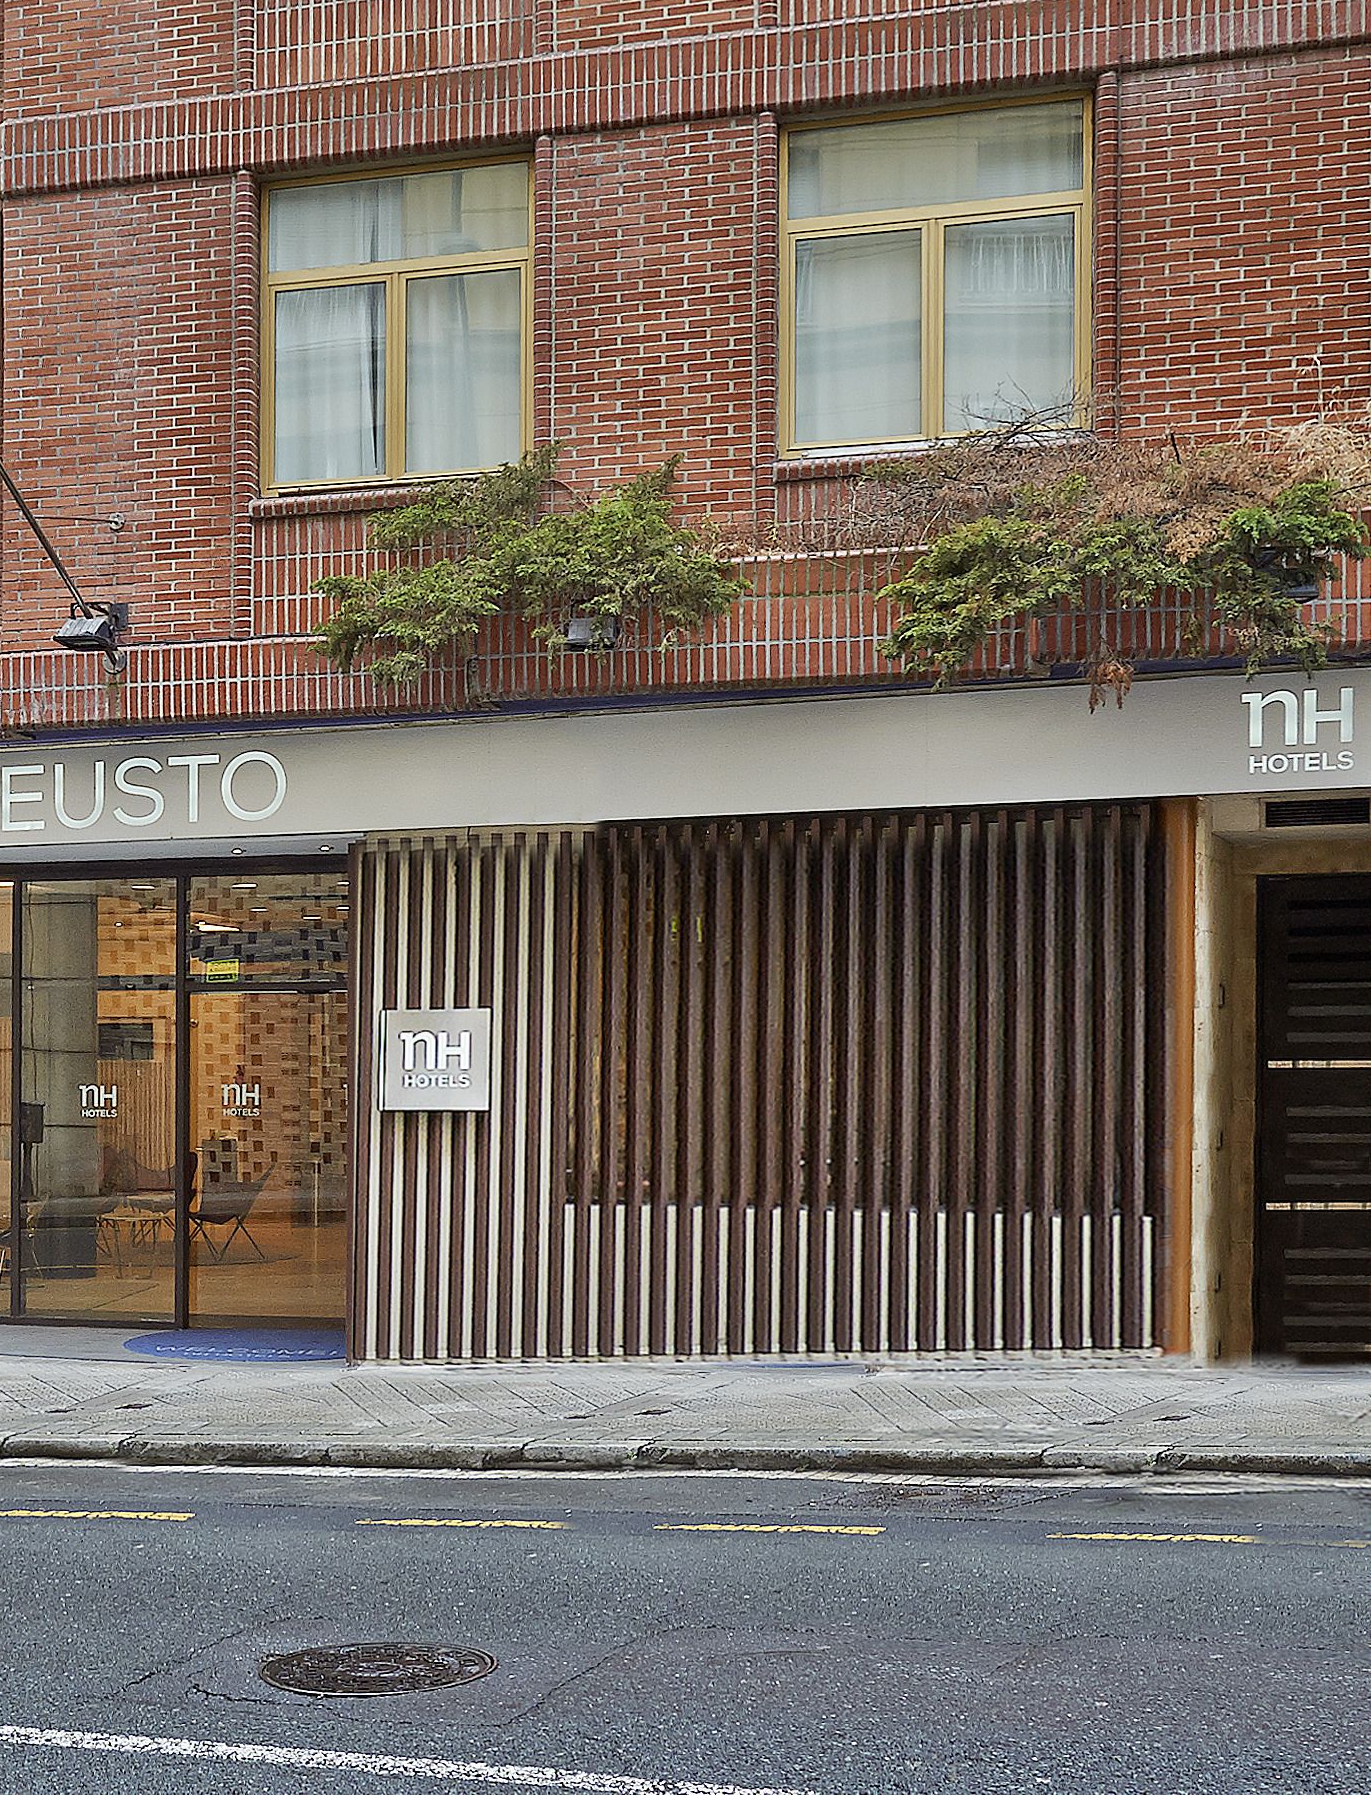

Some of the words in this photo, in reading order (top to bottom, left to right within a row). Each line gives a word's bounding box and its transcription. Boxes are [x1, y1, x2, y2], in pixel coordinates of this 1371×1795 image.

[1249, 750, 1355, 774] HOTELS
[403, 1073, 472, 1089] HOTELS
[82, 1108, 118, 1118] HOTELS
[223, 1107, 260, 1117] HOTELS
